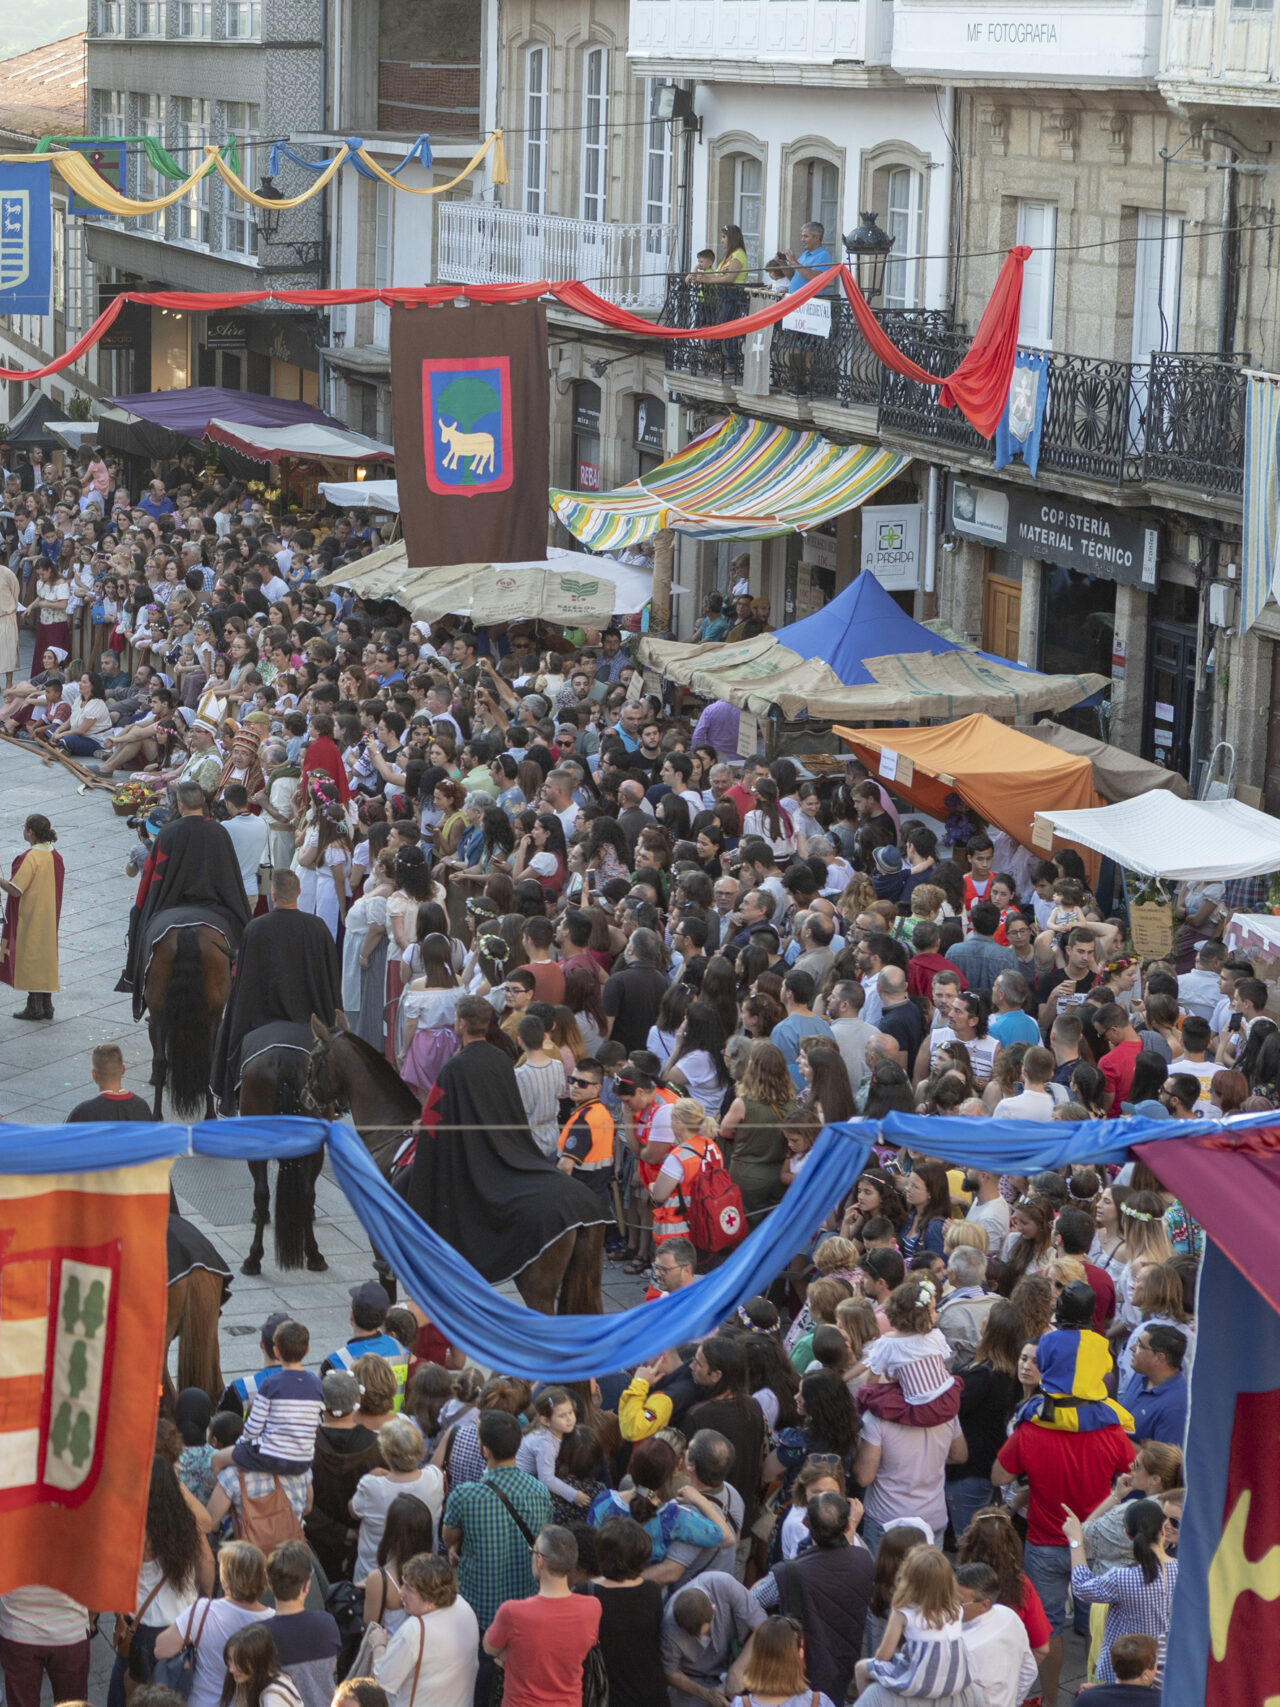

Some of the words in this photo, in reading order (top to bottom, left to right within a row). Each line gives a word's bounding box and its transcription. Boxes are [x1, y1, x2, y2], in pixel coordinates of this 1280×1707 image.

[967, 23, 983, 42] MF
[988, 23, 1058, 43] FOTOGRAFIA
[208, 320, 246, 337] Aire
[1041, 506, 1112, 538] COPISTERÍA
[1019, 522, 1074, 551] MATERIAL
[1080, 538, 1133, 567] TÉCNICO
[866, 552, 874, 564] A
[877, 551, 915, 564] PASADA
